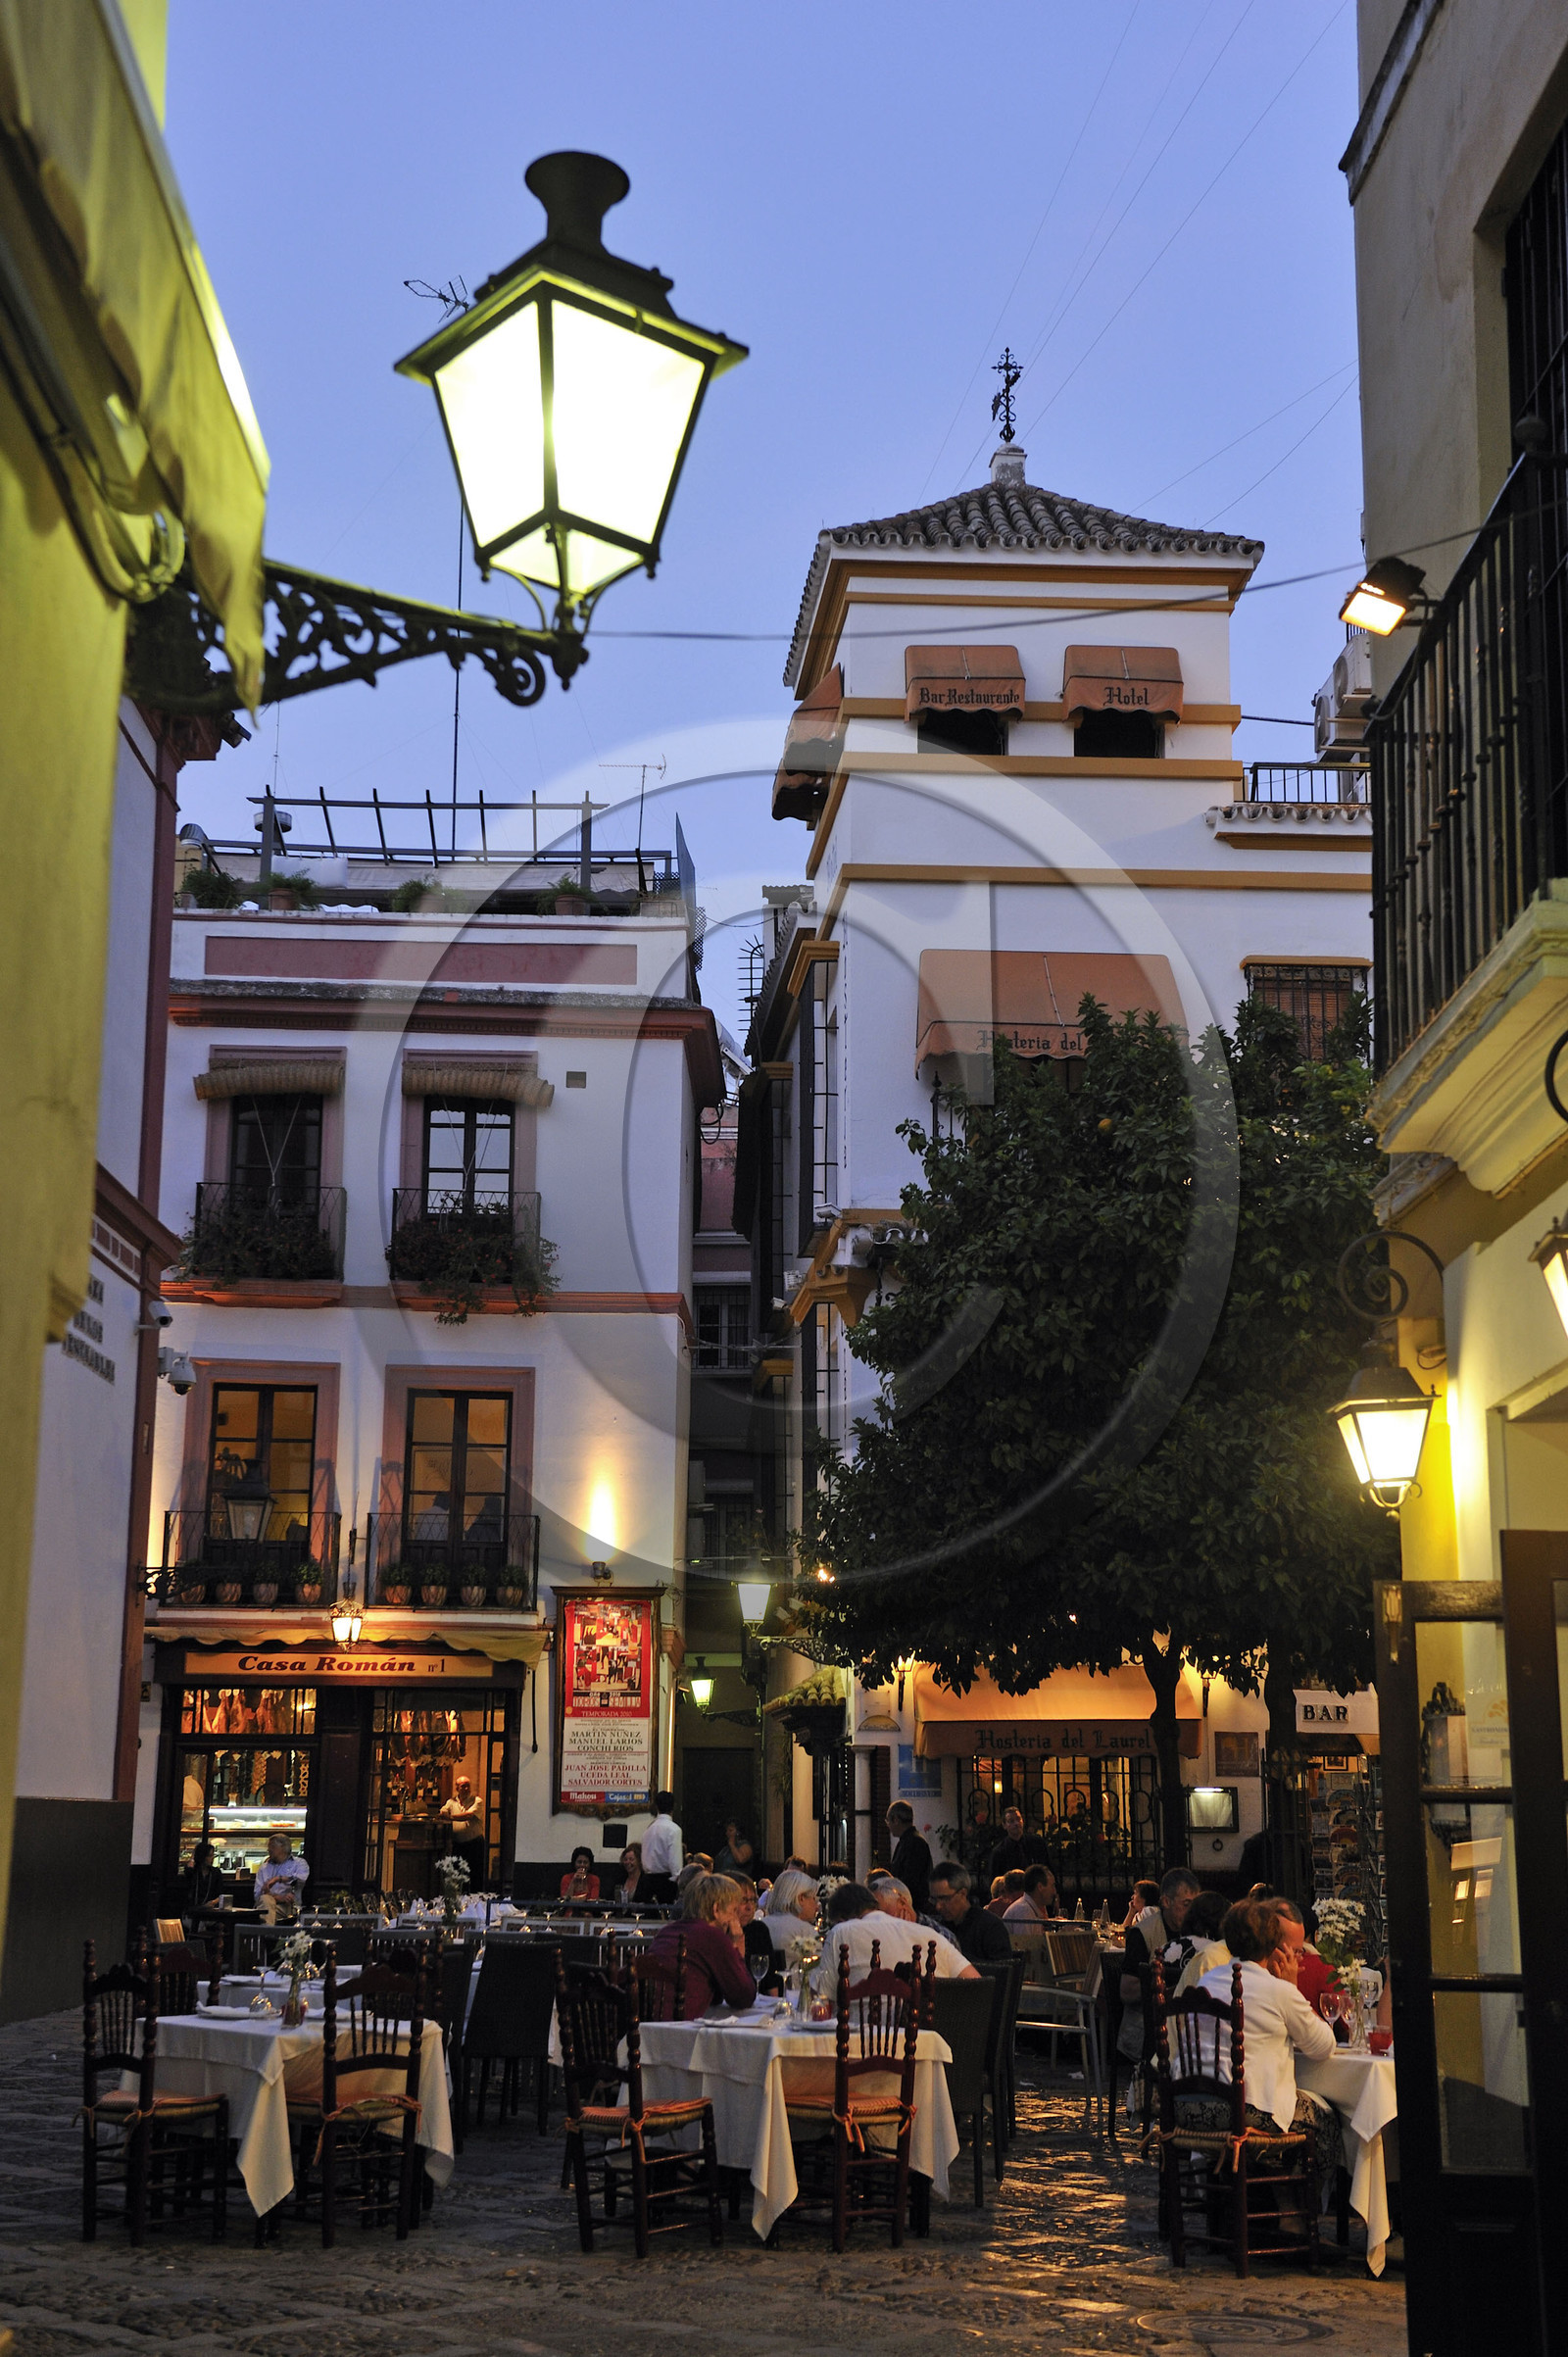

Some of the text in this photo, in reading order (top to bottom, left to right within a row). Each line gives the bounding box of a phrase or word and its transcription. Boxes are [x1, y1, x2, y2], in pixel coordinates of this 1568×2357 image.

[919, 687, 1020, 706] Bar Restaurante
[1102, 686, 1151, 707] Hotel
[1060, 1032, 1084, 1052] del
[238, 1655, 308, 1671] Casa
[314, 1655, 416, 1672] Román
[1302, 1704, 1348, 1721] BAR
[975, 1728, 1152, 1750] Hosteria del Laurel
[569, 1792, 597, 1800] Mahou
